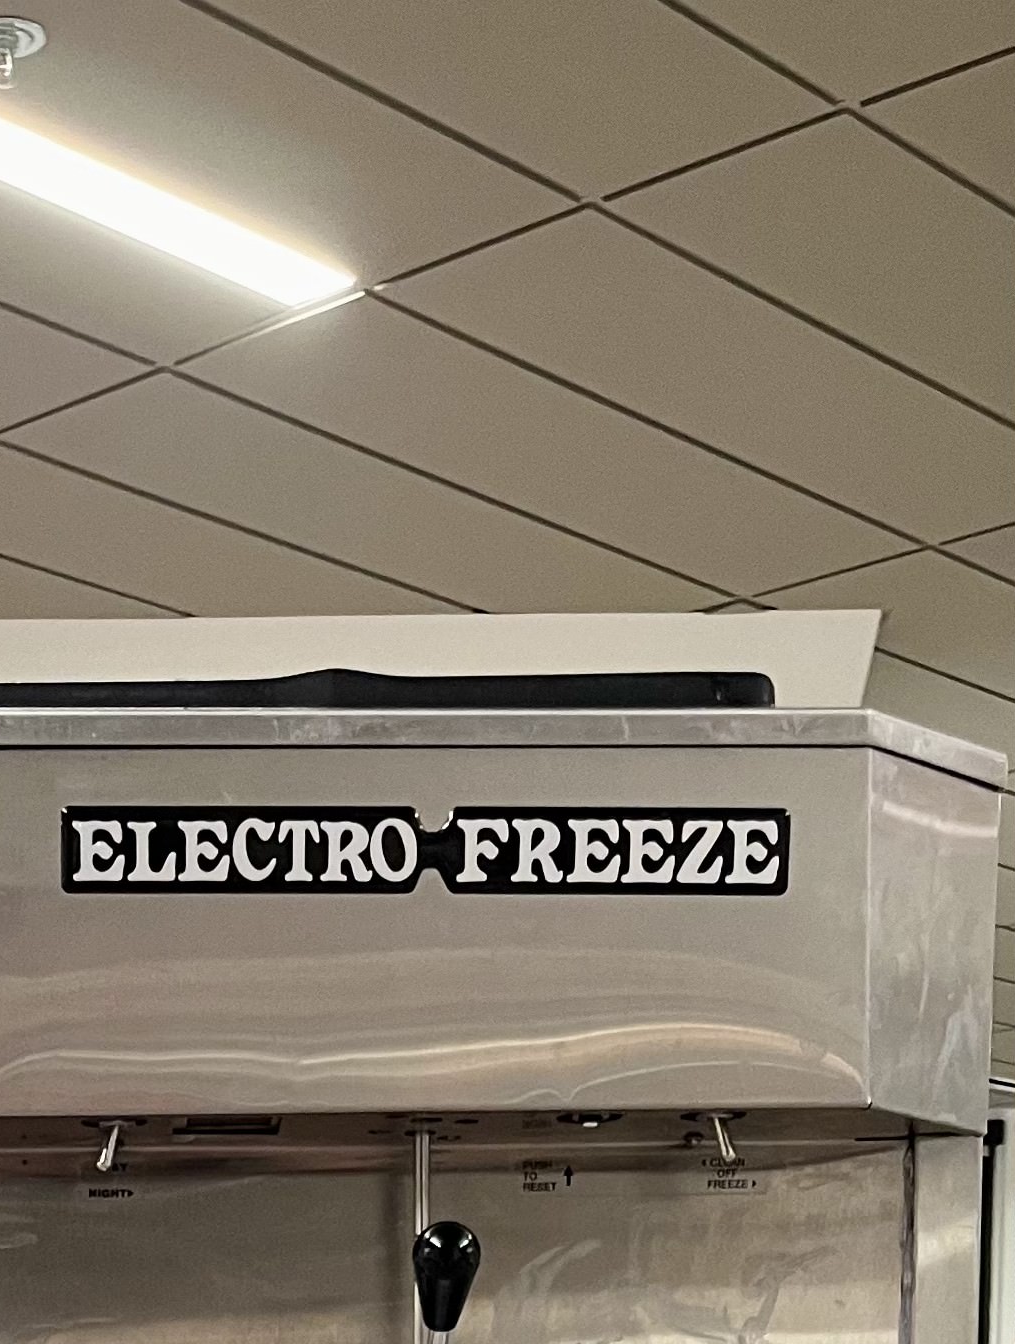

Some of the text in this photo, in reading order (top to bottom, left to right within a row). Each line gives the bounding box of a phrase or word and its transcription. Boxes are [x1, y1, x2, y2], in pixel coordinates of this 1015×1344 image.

[73, 818, 780, 884] ELECTRO FREEZE
[524, 1172, 537, 1181] TO
[717, 1168, 737, 1178] OFF
[523, 1182, 556, 1192] RESET
[707, 1180, 748, 1189] FREEZE
